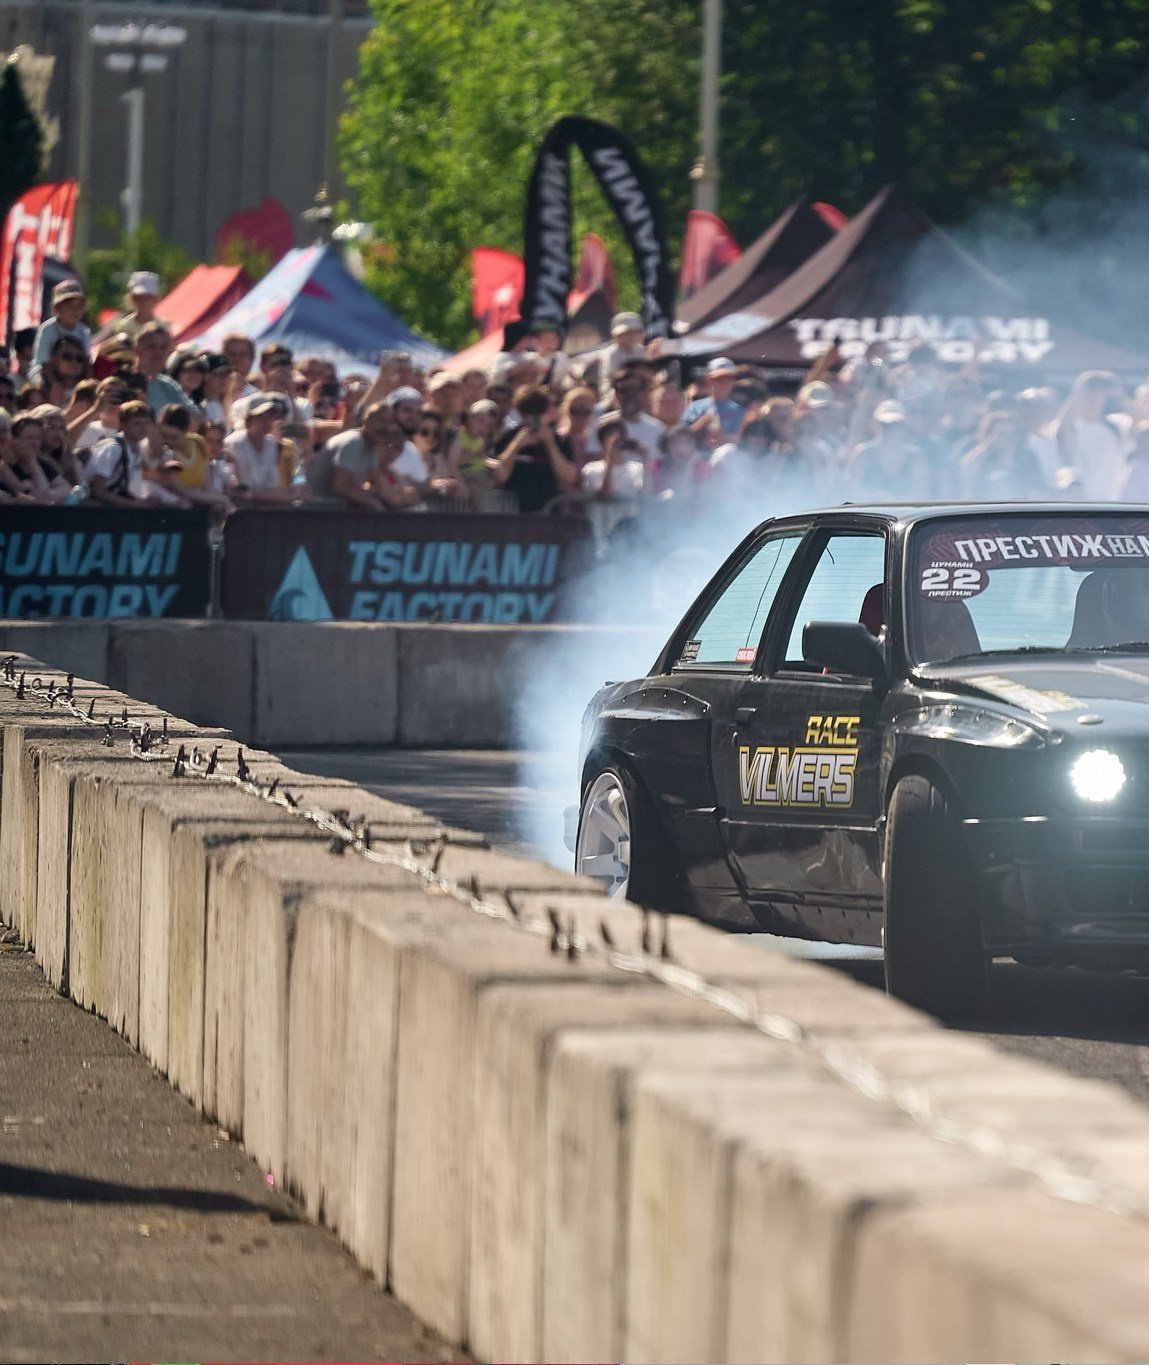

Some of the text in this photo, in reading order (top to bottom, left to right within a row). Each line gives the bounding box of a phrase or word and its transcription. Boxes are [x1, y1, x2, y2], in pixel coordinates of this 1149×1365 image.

[0, 532, 182, 577] UNAMI
[348, 540, 559, 585] TSUNAMI
[954, 534, 1109, 563] ПРЕСТИЖ
[921, 568, 981, 591] 22
[931, 561, 974, 569] ЦУНАМИ
[928, 590, 973, 598] ПРЕСТИЖ
[805, 715, 861, 746] RACE
[738, 745, 859, 808] VILMERS
